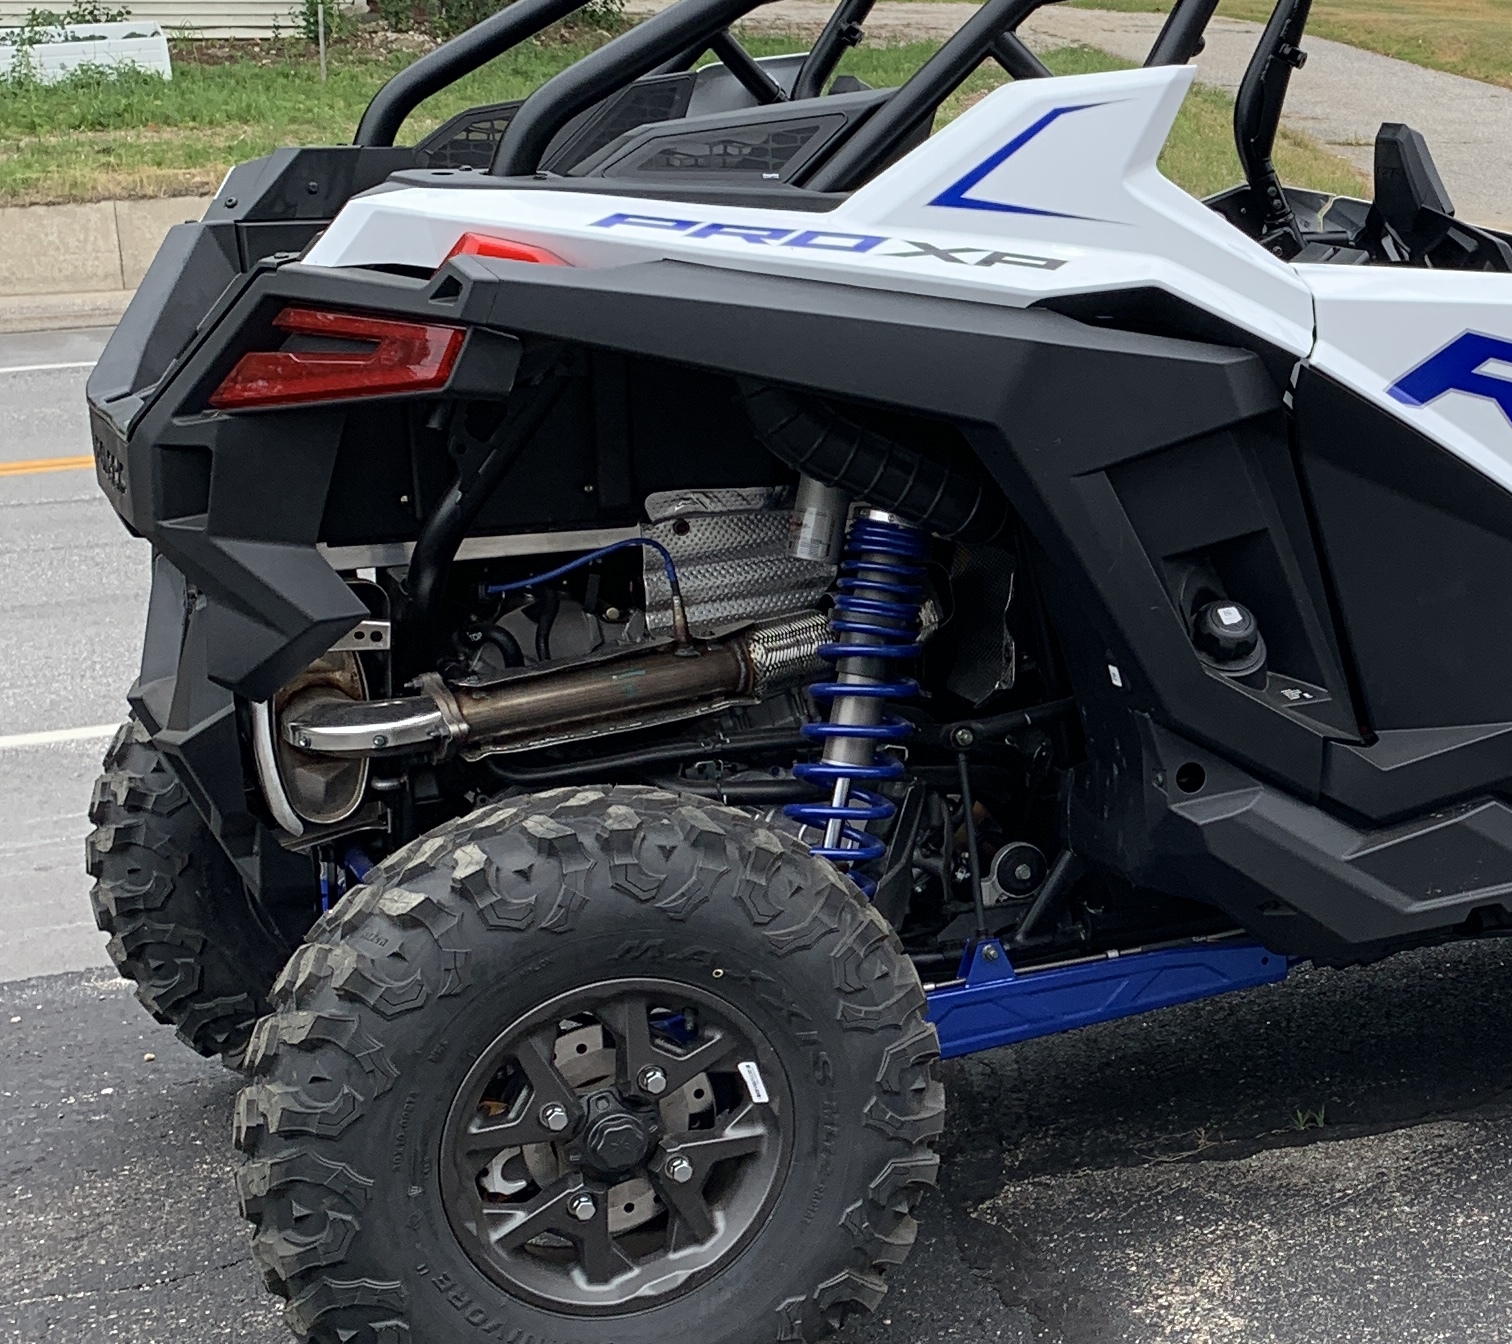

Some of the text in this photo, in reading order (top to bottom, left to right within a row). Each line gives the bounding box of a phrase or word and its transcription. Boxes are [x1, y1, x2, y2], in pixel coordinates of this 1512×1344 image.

[587, 212, 1070, 270] PRO XP
[606, 937, 833, 1085] MAXXIS
